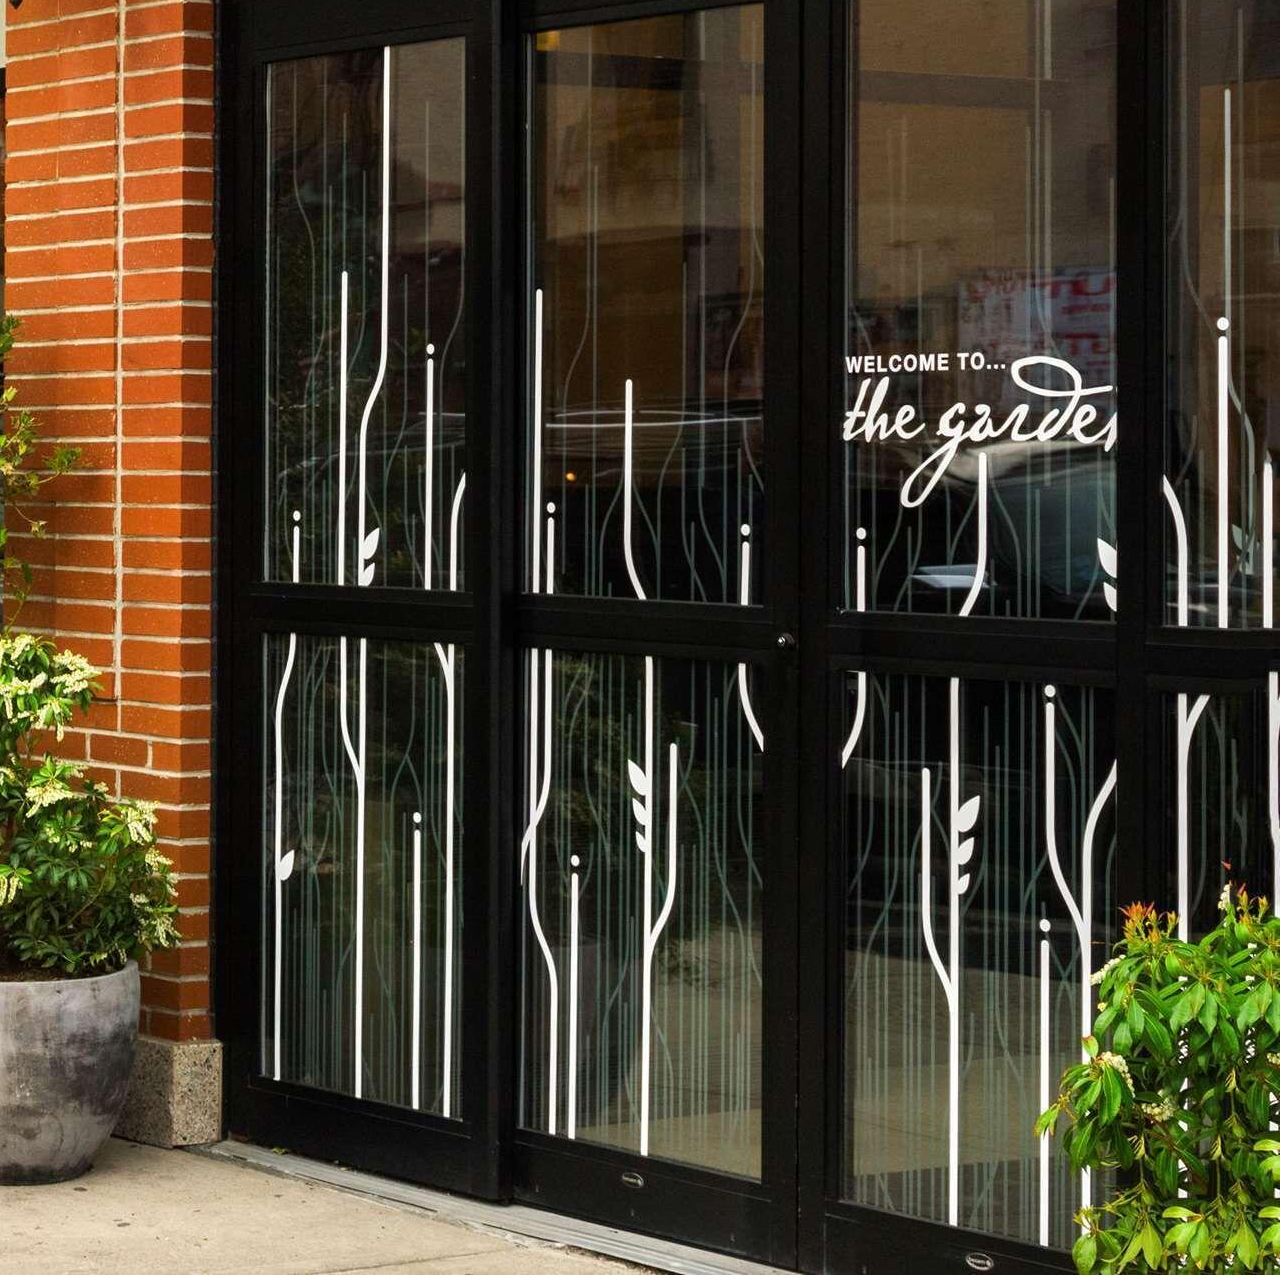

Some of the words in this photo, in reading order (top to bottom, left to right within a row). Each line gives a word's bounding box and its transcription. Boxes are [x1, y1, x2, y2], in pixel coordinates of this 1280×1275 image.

[845, 352, 950, 375] WELCOME
[956, 351, 1007, 372] TO...
[842, 375, 927, 444] the
